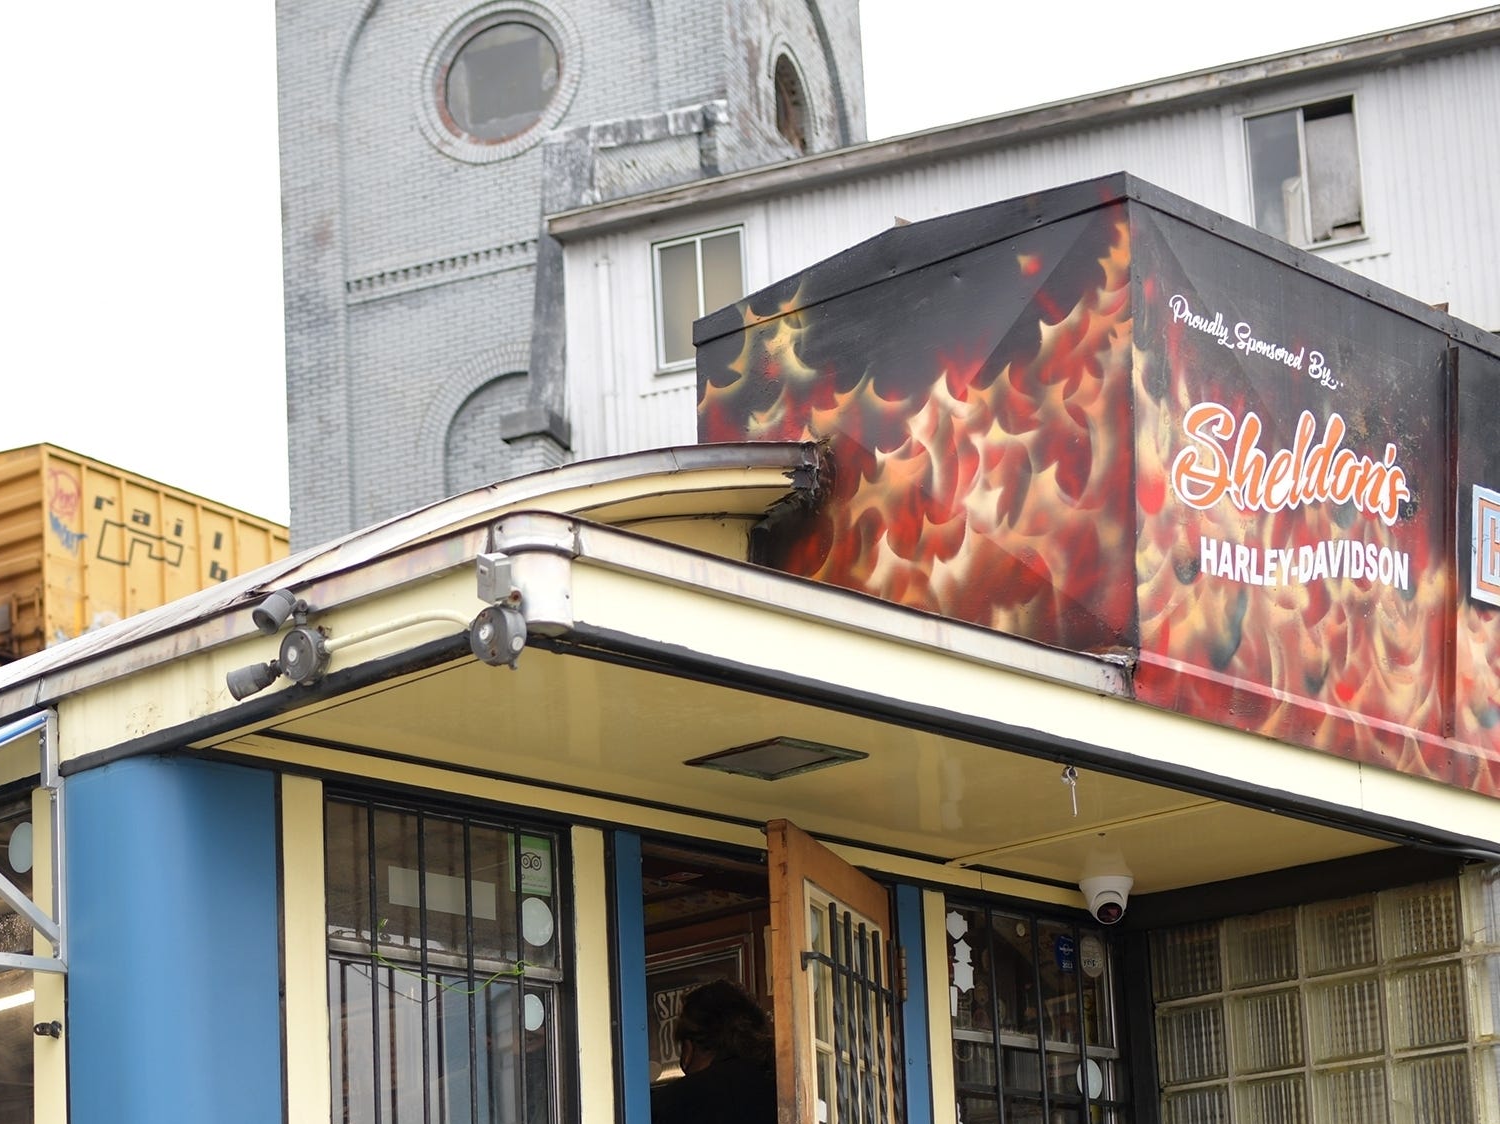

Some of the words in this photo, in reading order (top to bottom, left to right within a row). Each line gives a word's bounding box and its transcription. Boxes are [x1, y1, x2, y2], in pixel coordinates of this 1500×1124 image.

[1169, 294, 1235, 350] Proudly
[1234, 322, 1305, 371] Sponsored
[1172, 401, 1411, 527] Sheldon's
[1199, 535, 1410, 591] HARLEY-DAVIDSON
